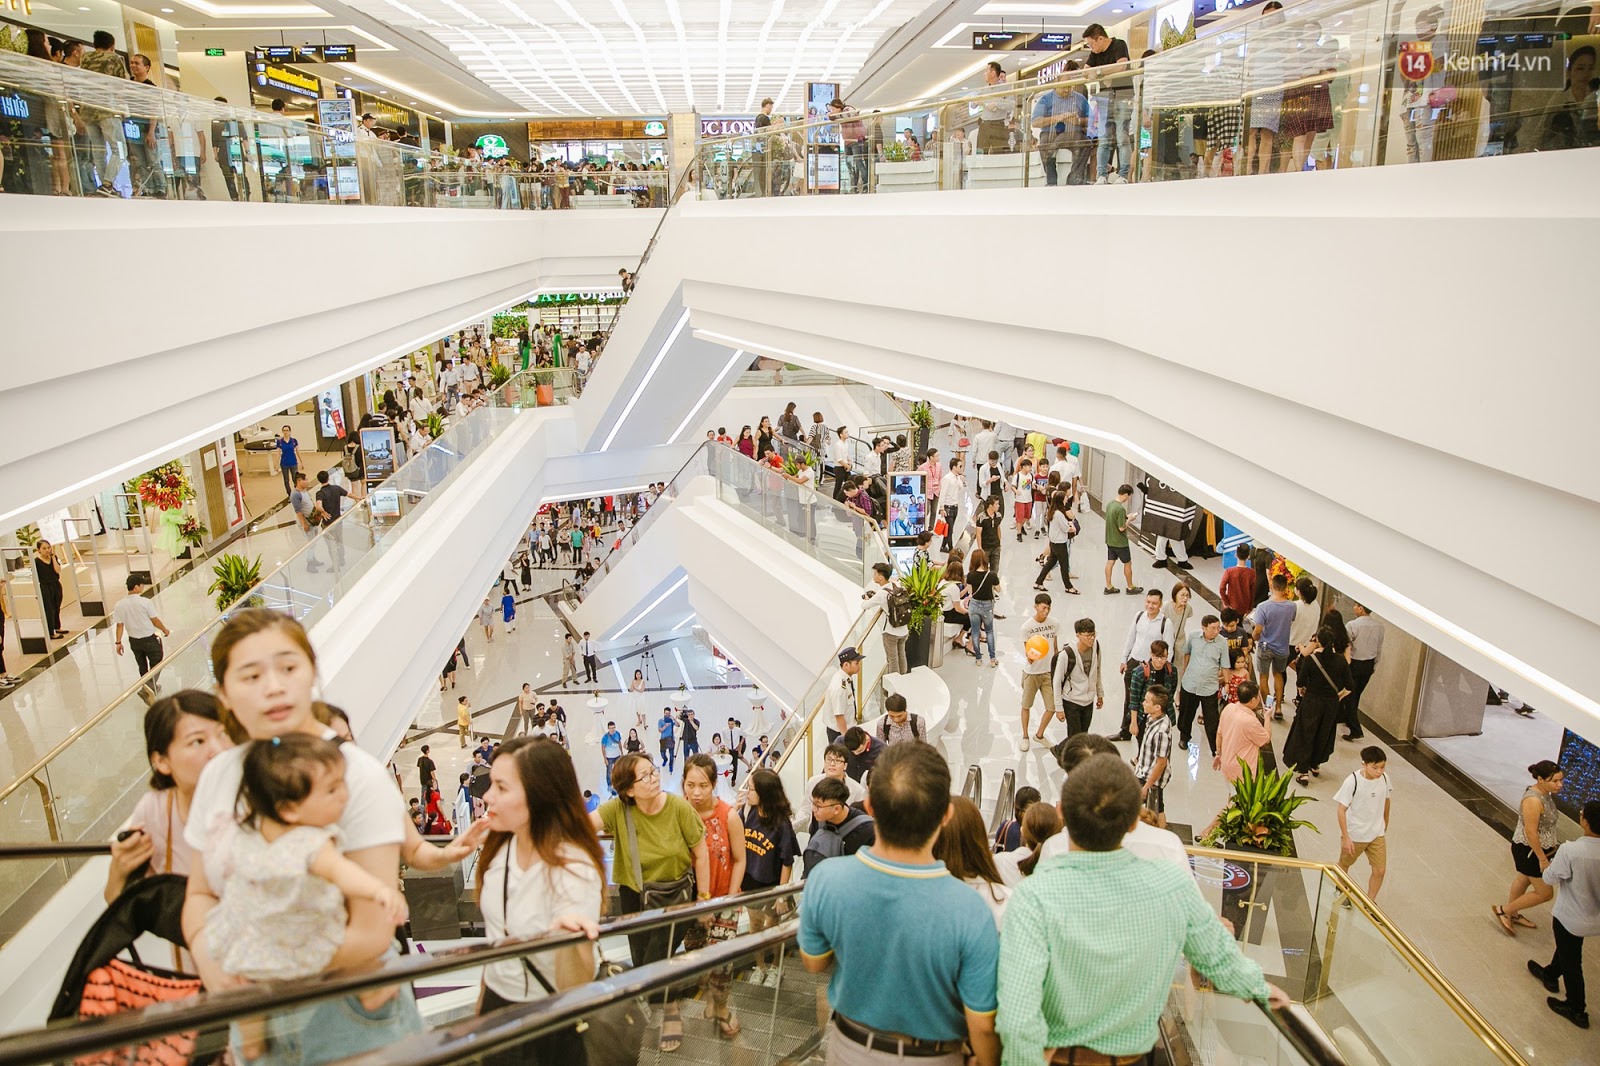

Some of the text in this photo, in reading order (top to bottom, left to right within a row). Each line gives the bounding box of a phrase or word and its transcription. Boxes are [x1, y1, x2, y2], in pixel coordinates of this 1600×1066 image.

[721, 121, 756, 135] LON
[744, 828, 775, 851] EAT IT
